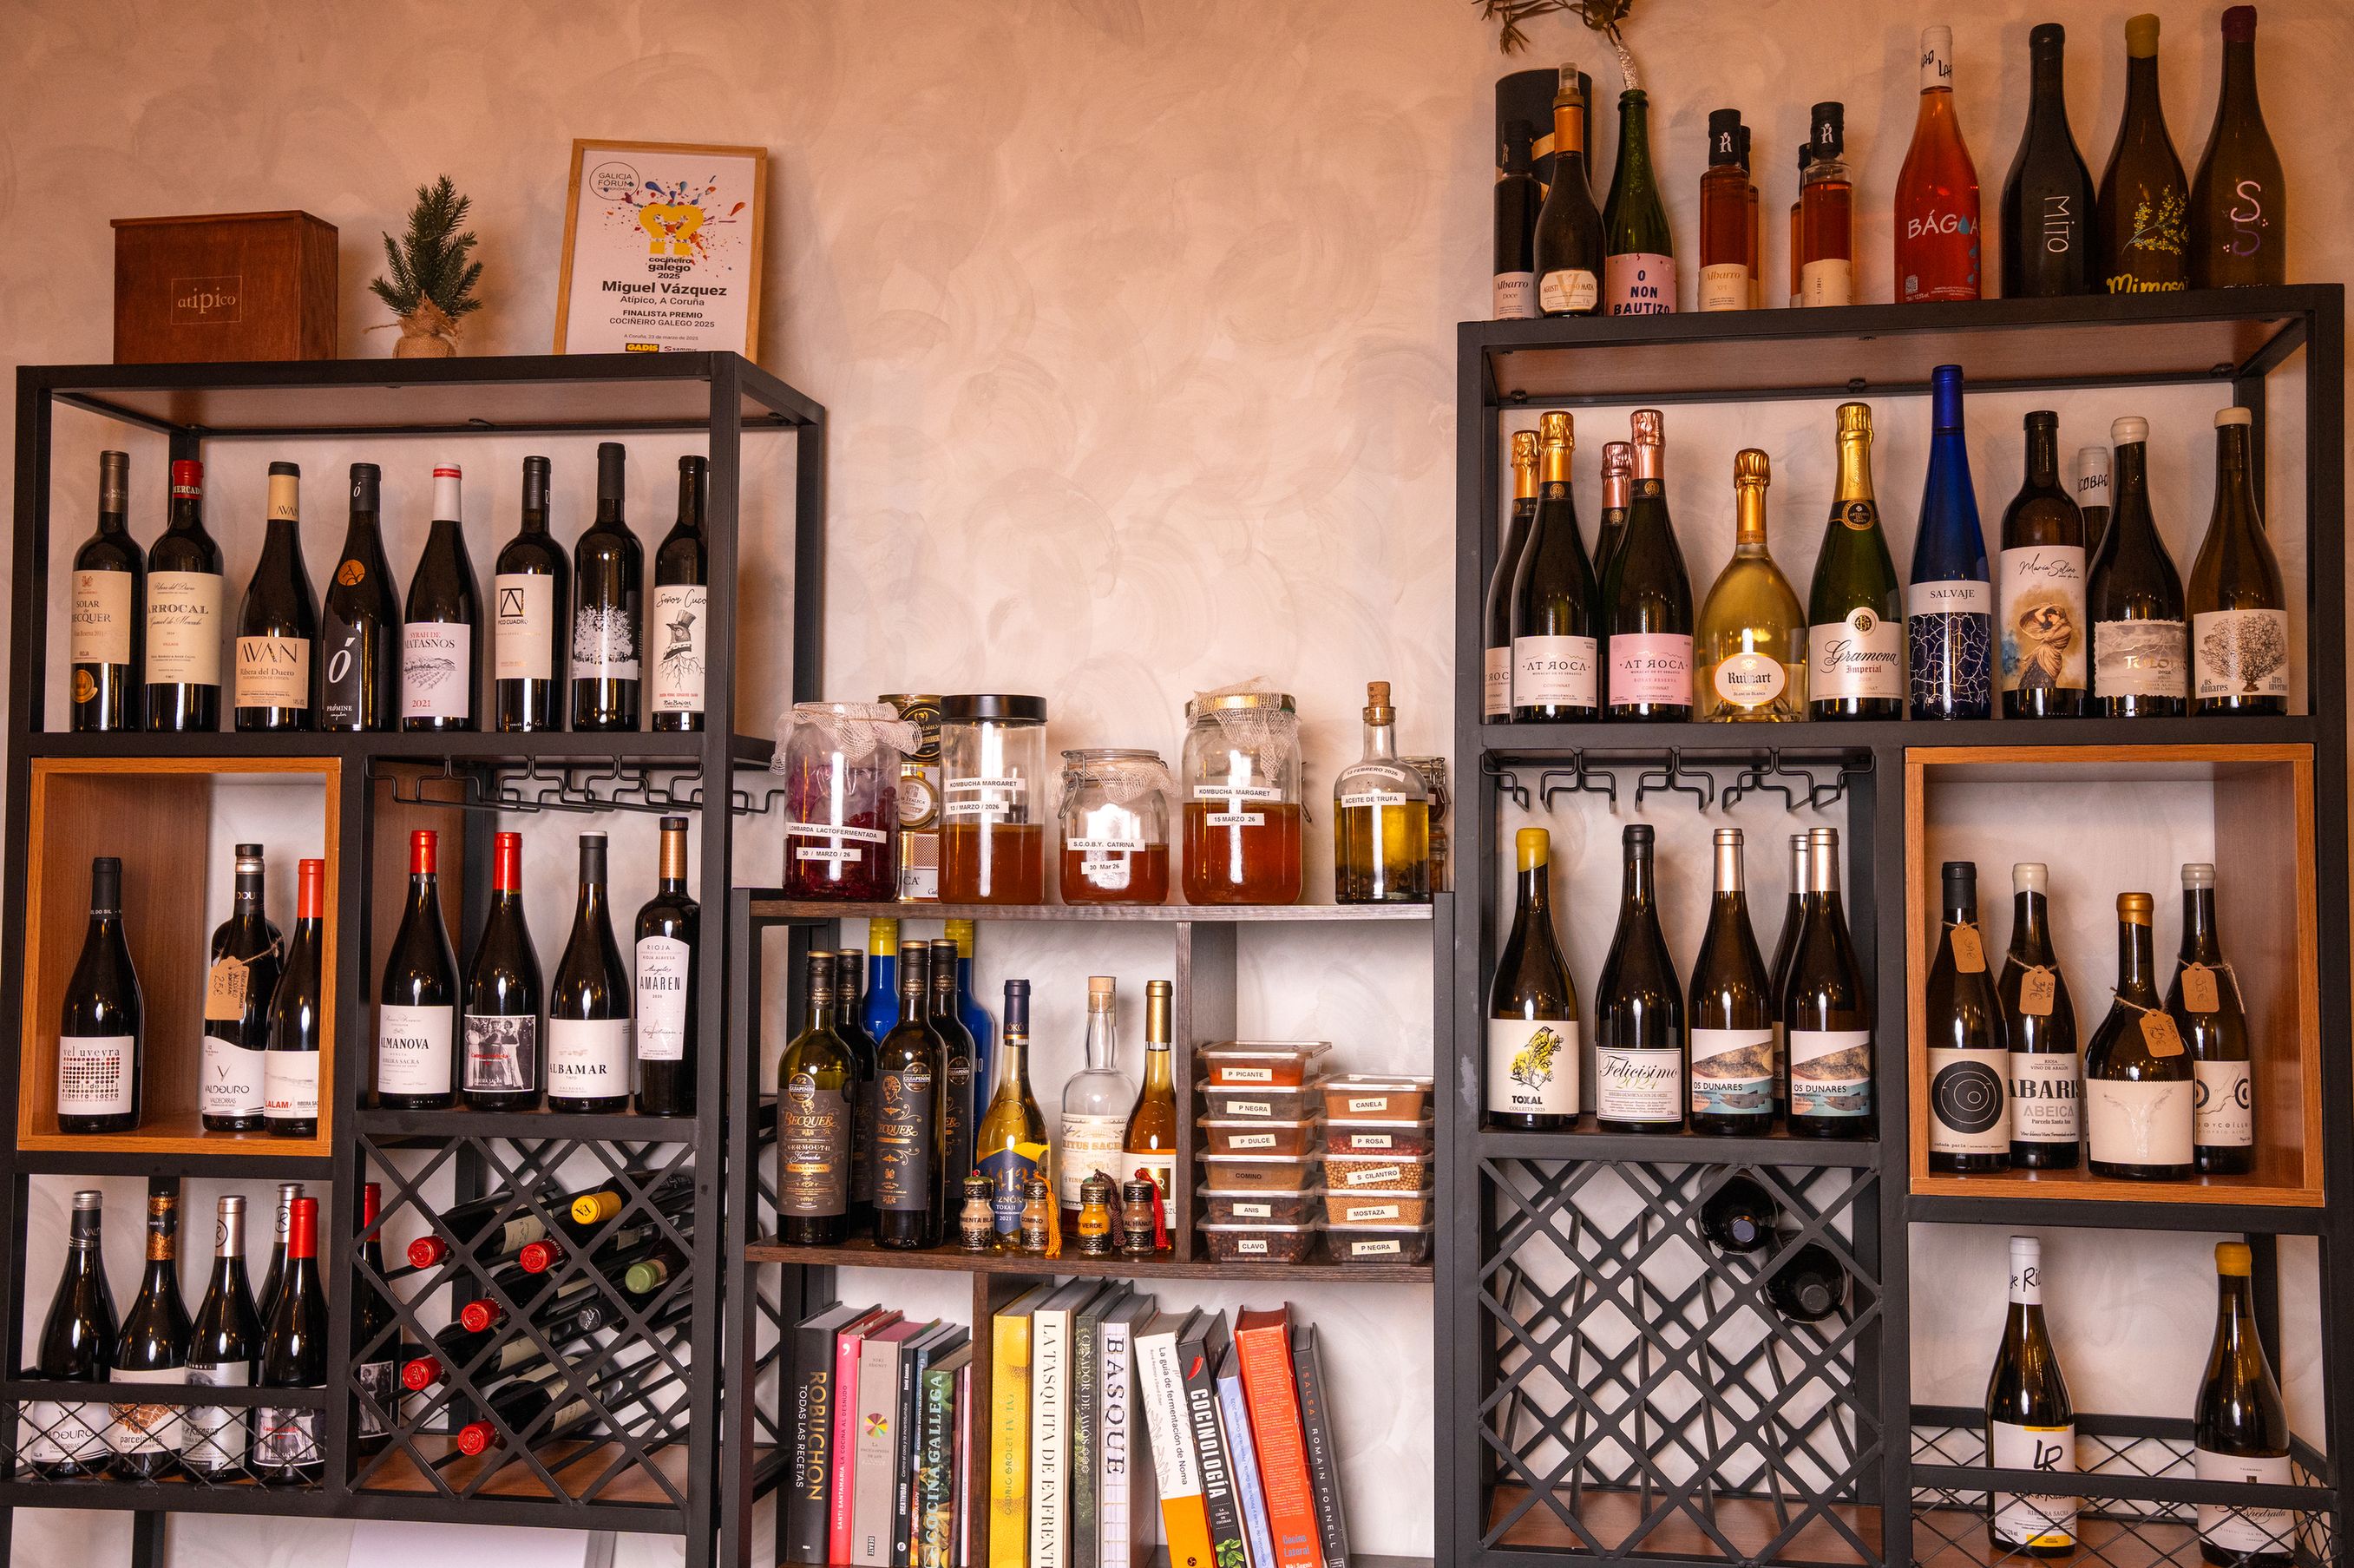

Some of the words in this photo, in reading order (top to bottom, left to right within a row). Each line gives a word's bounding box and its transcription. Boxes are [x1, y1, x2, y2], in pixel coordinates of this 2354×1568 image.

[648, 261, 692, 272] galego
[1637, 270, 1646, 282] O
[601, 280, 656, 295] Miguel
[660, 282, 728, 297] Vázquez
[1629, 285, 1658, 299] NON
[177, 287, 236, 314] atipico
[620, 296, 658, 305] Atípico,
[670, 297, 705, 306] Coruña
[609, 317, 657, 326] COCIÑEIRO
[658, 318, 693, 327] GALEGO
[693, 319, 716, 328] 2025
[656, 593, 682, 607] Señor
[1930, 589, 1976, 599] SALVAJE
[239, 642, 298, 663] AVAN
[1820, 639, 1899, 674] Gramona
[328, 637, 356, 684] Ó
[1527, 662, 1544, 671] AT
[1625, 659, 1643, 669] AT
[271, 668, 295, 677] Duero
[1846, 665, 1882, 674] Imperial
[1728, 672, 1772, 685] Ruinart
[2272, 675, 2283, 684] tres
[411, 699, 431, 708] 2021
[1384, 768, 1399, 777] 2026
[816, 828, 877, 839] LACTOFERMENTADA
[639, 976, 681, 990] AMAREN
[1703, 1082, 1743, 1091] DUNARES
[1806, 1085, 1847, 1093] DUNARES
[1511, 1095, 1543, 1105] TOXAL
[2023, 1105, 2075, 1118] ABEICA
[784, 1112, 835, 1128] BECQUER
[1365, 1170, 1398, 1179] CILANTRO
[1043, 1324, 1056, 1346] LA
[1158, 1347, 1166, 1356] La
[1081, 1335, 1091, 1391] CENADOR
[1162, 1358, 1170, 1375] guía
[1164, 1377, 1171, 1388] de
[798, 1385, 808, 1420] TODAS
[1040, 1350, 1056, 1442] TASQUITA
[1081, 1394, 1091, 1411] DE
[1106, 1337, 1125, 1474] BASQUE
[842, 1418, 847, 1428] AL
[928, 1375, 943, 1464] GALLEGA
[1166, 1389, 1181, 1445] fermentación
[797, 1422, 806, 1440] LAS
[806, 1371, 827, 1500] ROBUCHON
[1190, 1388, 1229, 1499] COCINOLOGÍA
[1176, 1447, 1184, 1459] de
[796, 1444, 805, 1488] RECETAS
[840, 1456, 845, 1466] LA
[1041, 1447, 1056, 1474] DE
[1178, 1460, 1188, 1485] Noma
[1311, 1427, 1326, 1480] ROMAIN
[1321, 1487, 1337, 1549] FORNELL
[899, 1482, 908, 1516] CREATIVIDAD
[925, 1465, 941, 1545] COCINA
[1282, 1534, 1307, 1545] Cocina
